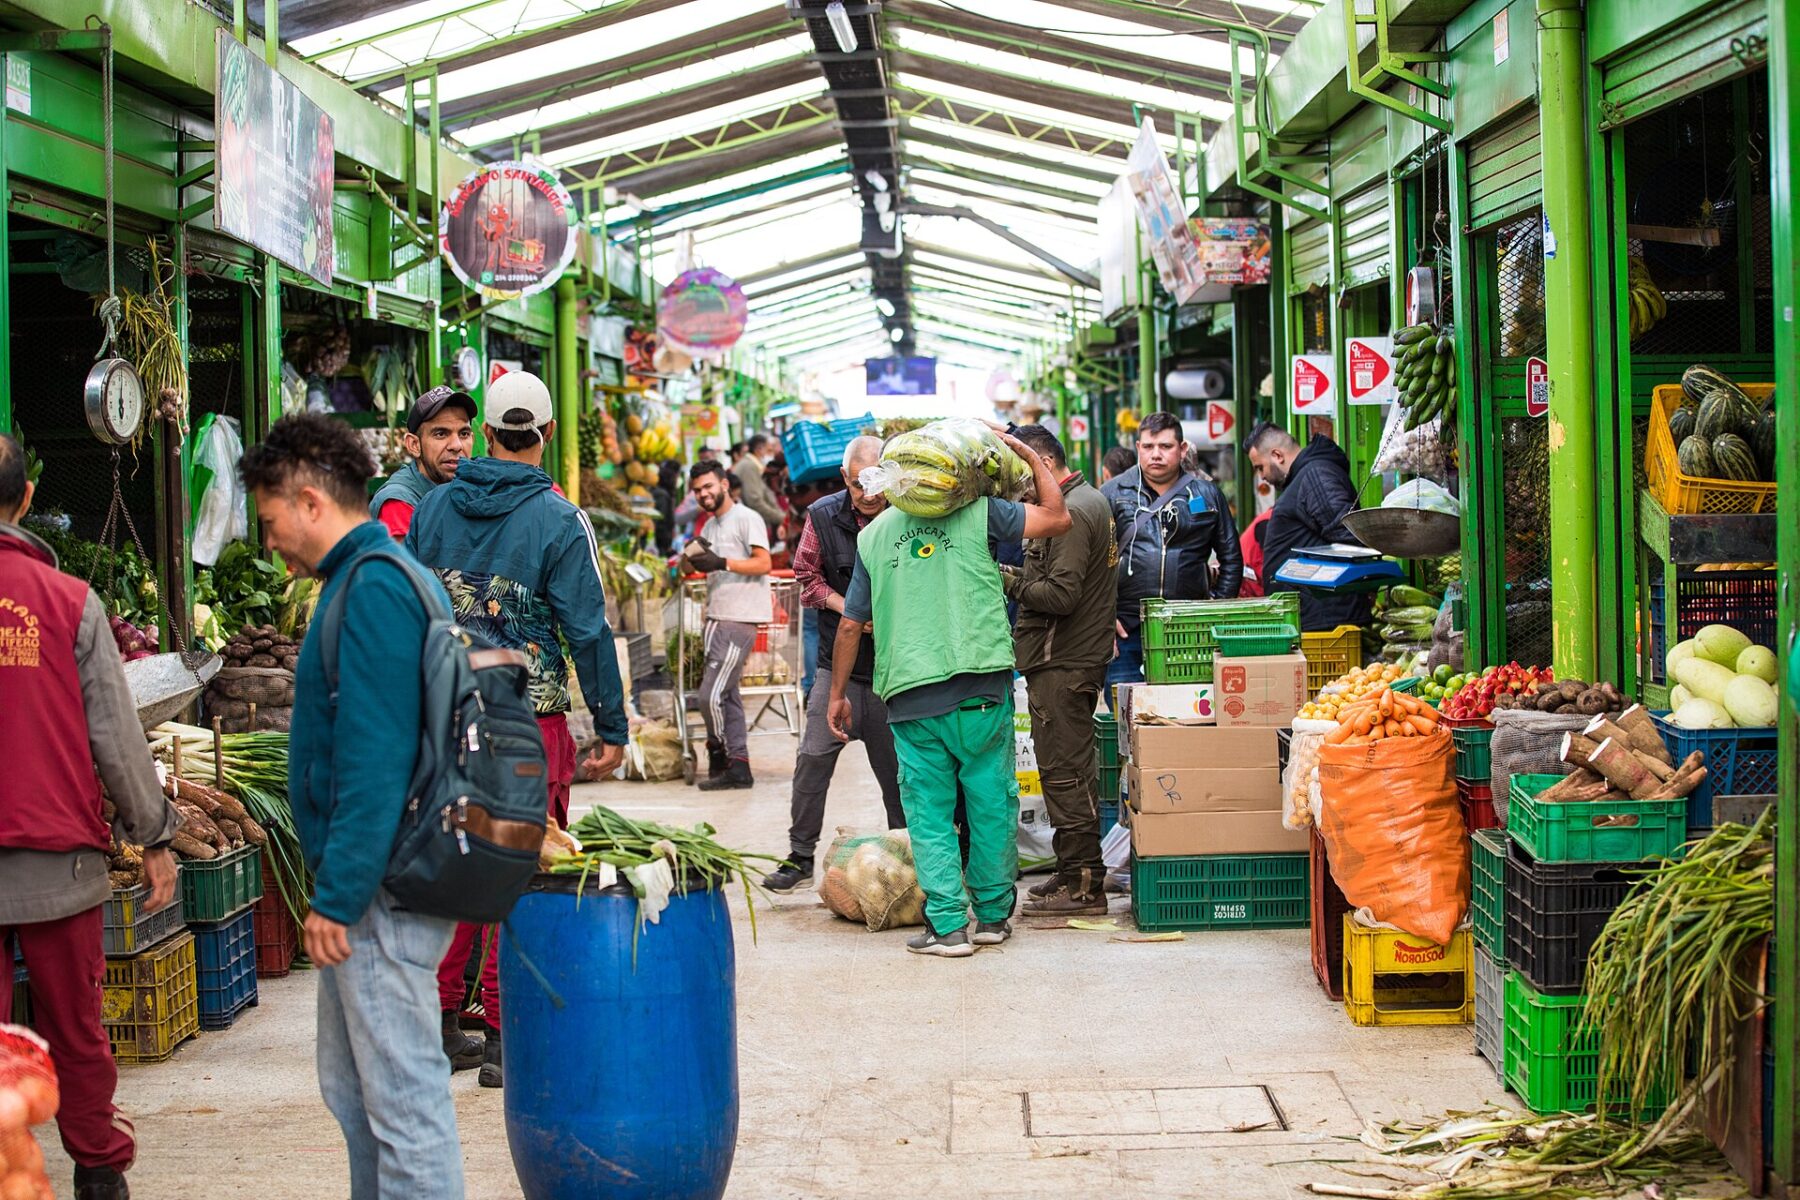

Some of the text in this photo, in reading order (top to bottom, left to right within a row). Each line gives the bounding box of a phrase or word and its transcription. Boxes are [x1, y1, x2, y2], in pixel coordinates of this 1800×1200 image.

[892, 526, 954, 569] EL AGUACATAL
[1214, 904, 1246, 912] OSPINA
[1214, 911, 1246, 919] CITRICOS
[1394, 945, 1445, 965] POSTOBON
